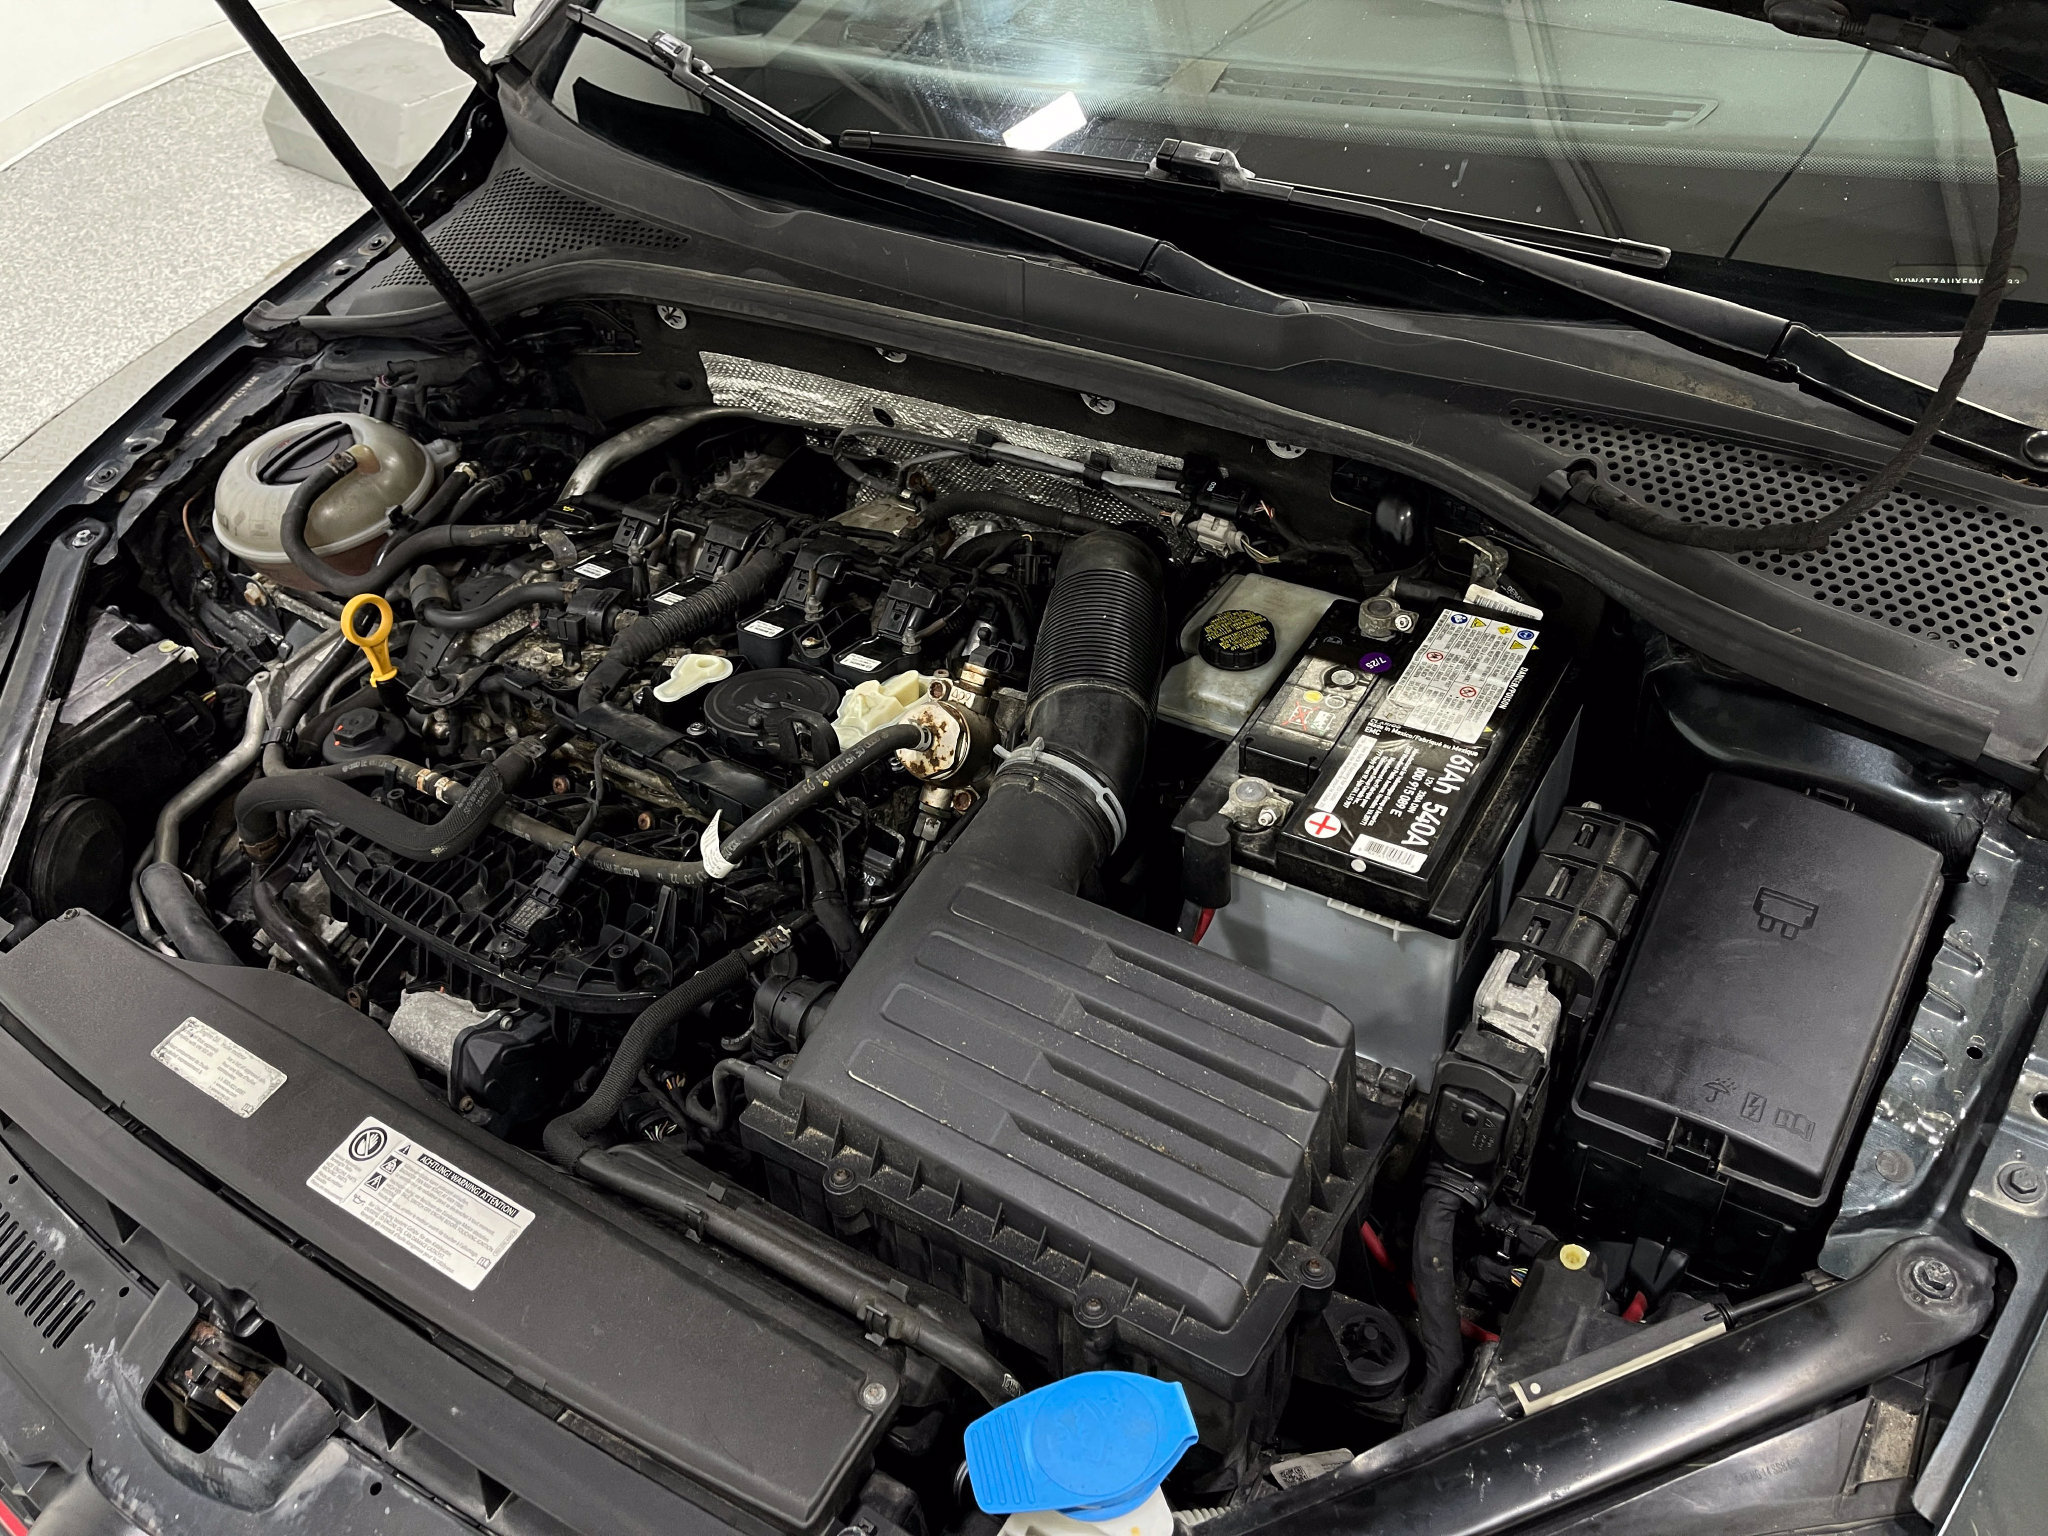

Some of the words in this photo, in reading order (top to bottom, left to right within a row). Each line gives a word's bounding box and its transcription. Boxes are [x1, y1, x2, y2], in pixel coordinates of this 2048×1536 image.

[1365, 657, 1387, 669] 7/25
[1496, 666, 1530, 710] DANGER/POISON
[1366, 721, 1384, 730] Made
[1450, 744, 1479, 758] Mexique
[1409, 766, 1428, 781] 000
[1421, 775, 1434, 787] 12V
[1430, 753, 1477, 797] 61Ah
[1401, 779, 1420, 795] 915
[1392, 793, 1411, 809] 089
[1405, 802, 1419, 814] DIN
[1388, 808, 1403, 817] E
[1399, 799, 1450, 852] 540A
[418, 1154, 453, 1178] ACHTUNG!
[448, 1172, 483, 1196] WARNING!
[478, 1190, 517, 1217] ATTENTION!
